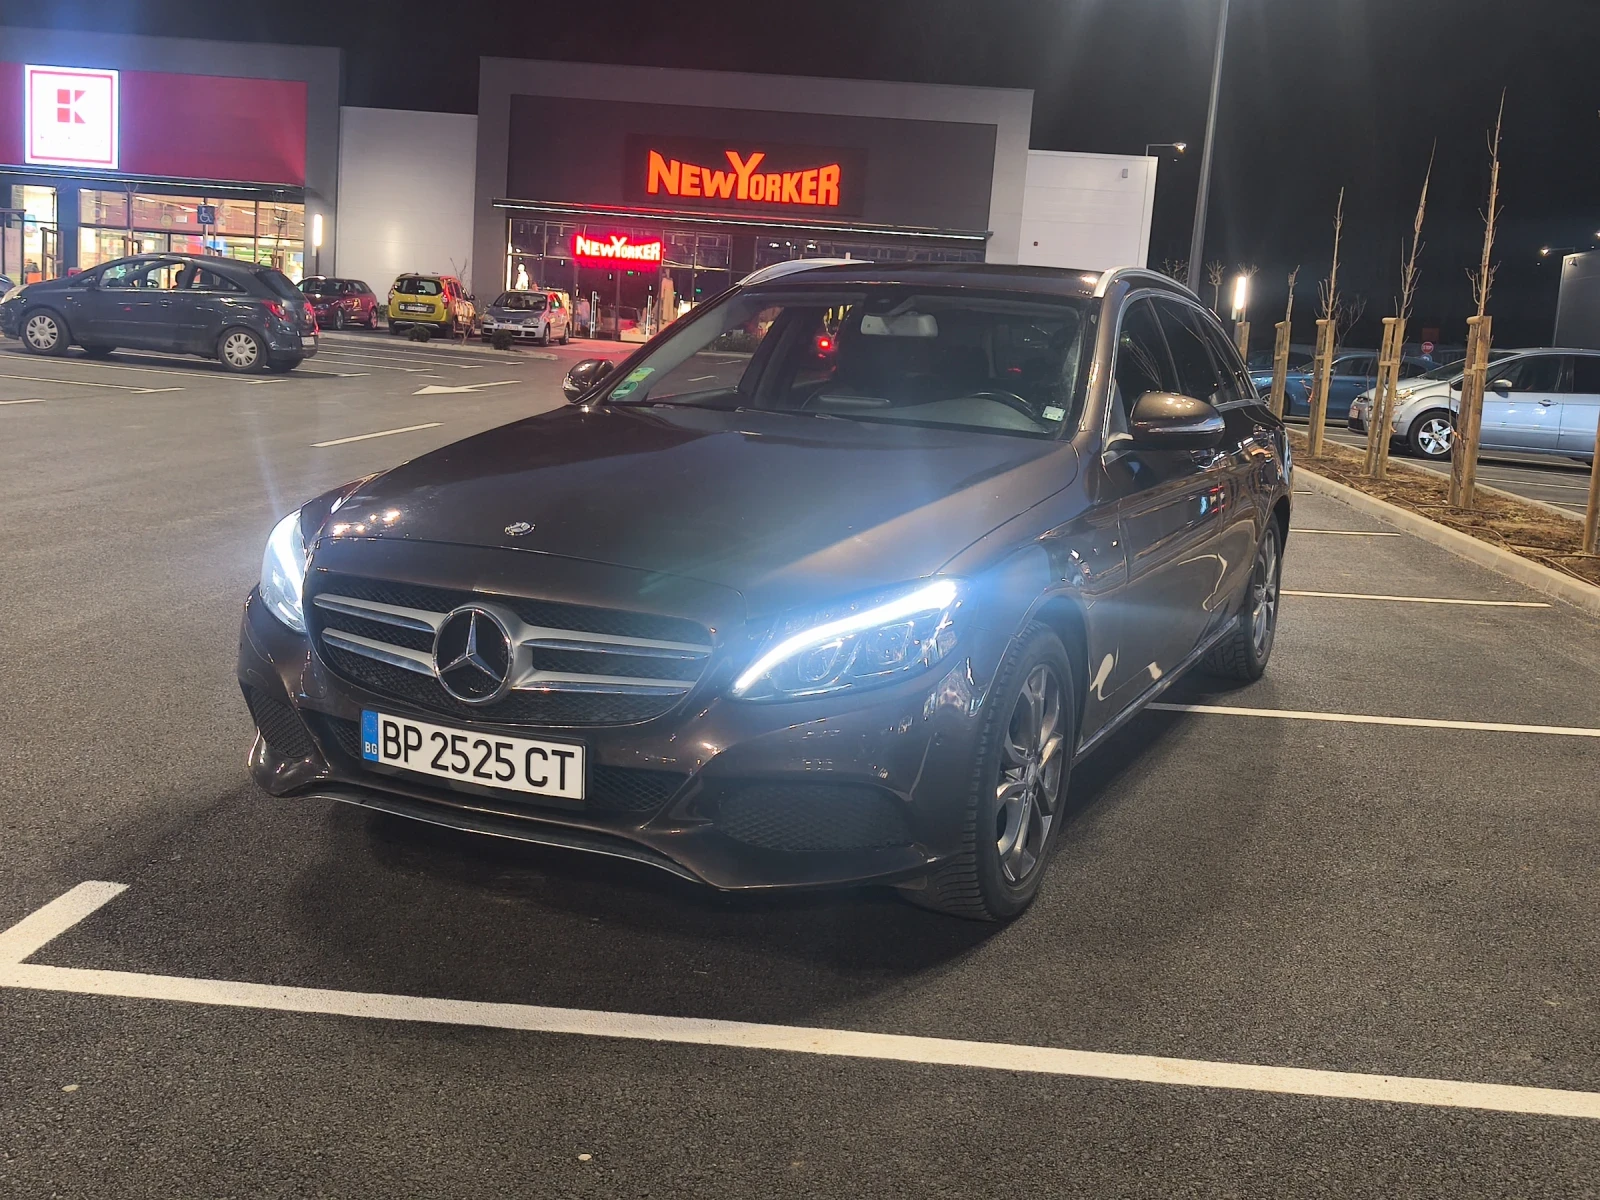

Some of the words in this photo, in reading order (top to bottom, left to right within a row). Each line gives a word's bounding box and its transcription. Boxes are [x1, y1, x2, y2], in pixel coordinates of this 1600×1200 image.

[365, 741, 377, 755] BG
[383, 720, 422, 763] BP
[430, 731, 515, 782] 2525
[525, 747, 574, 790] CT
